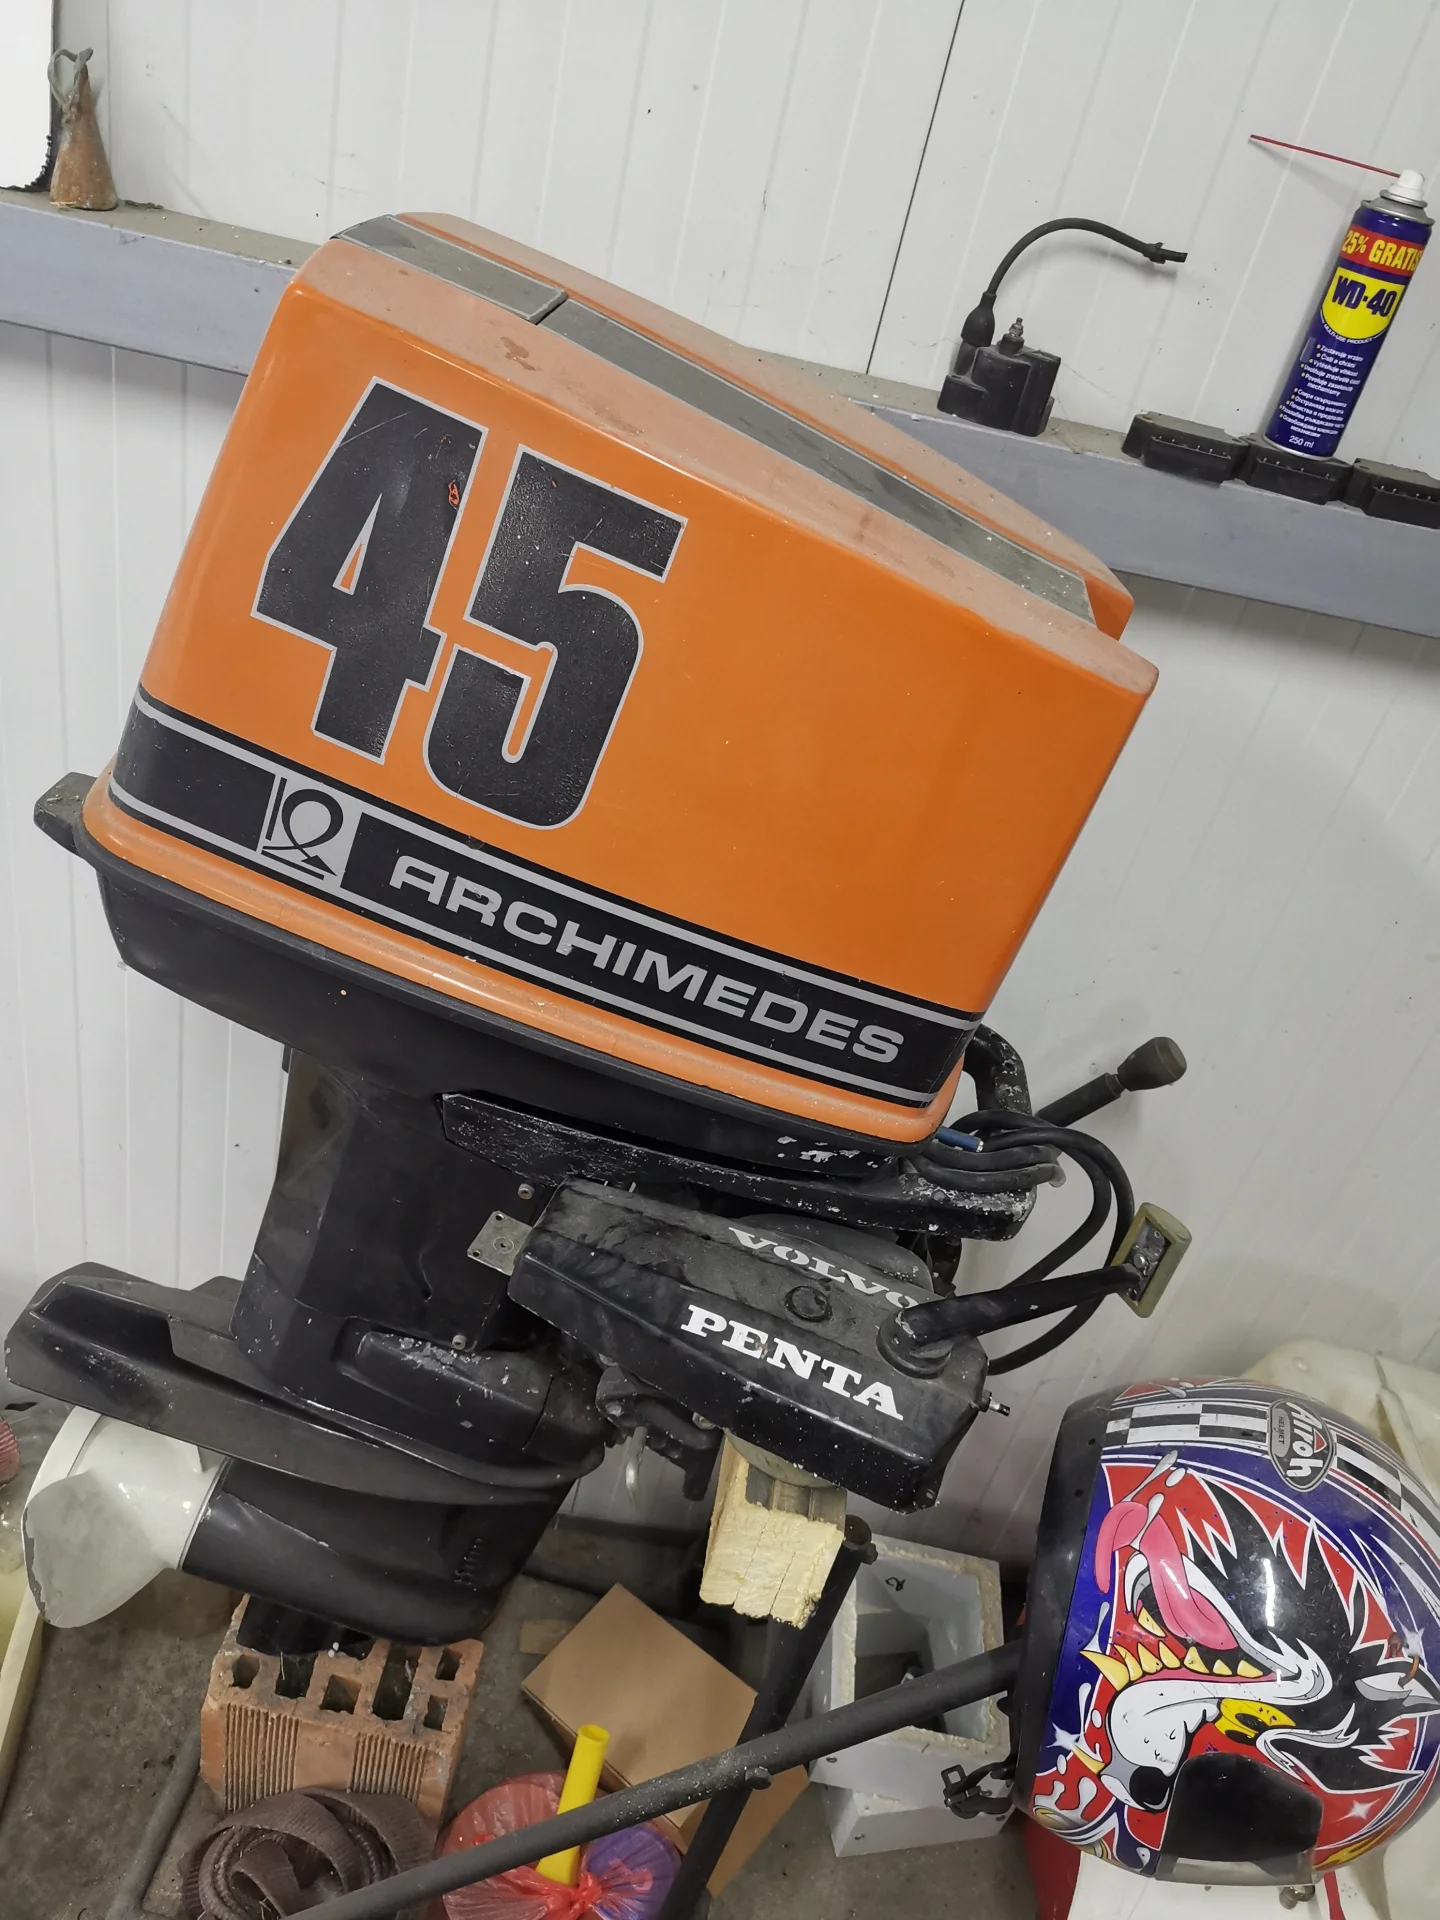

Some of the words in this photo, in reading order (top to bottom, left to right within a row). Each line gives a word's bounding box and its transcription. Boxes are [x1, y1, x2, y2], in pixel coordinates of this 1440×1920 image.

[1342, 230, 1369, 254] 25%
[1368, 239, 1424, 271] GRATIS
[1323, 323, 1346, 343] MULTI-USE
[1331, 275, 1398, 317] WD-40
[1288, 435, 1304, 446] 250
[1303, 440, 1315, 448] ml
[251, 377, 688, 830] 45
[388, 855, 904, 1064] ARCHIMEDES
[728, 1227, 918, 1309] VOLVO
[680, 1304, 904, 1420] PENTA
[1285, 1401, 1324, 1477] Airoh
